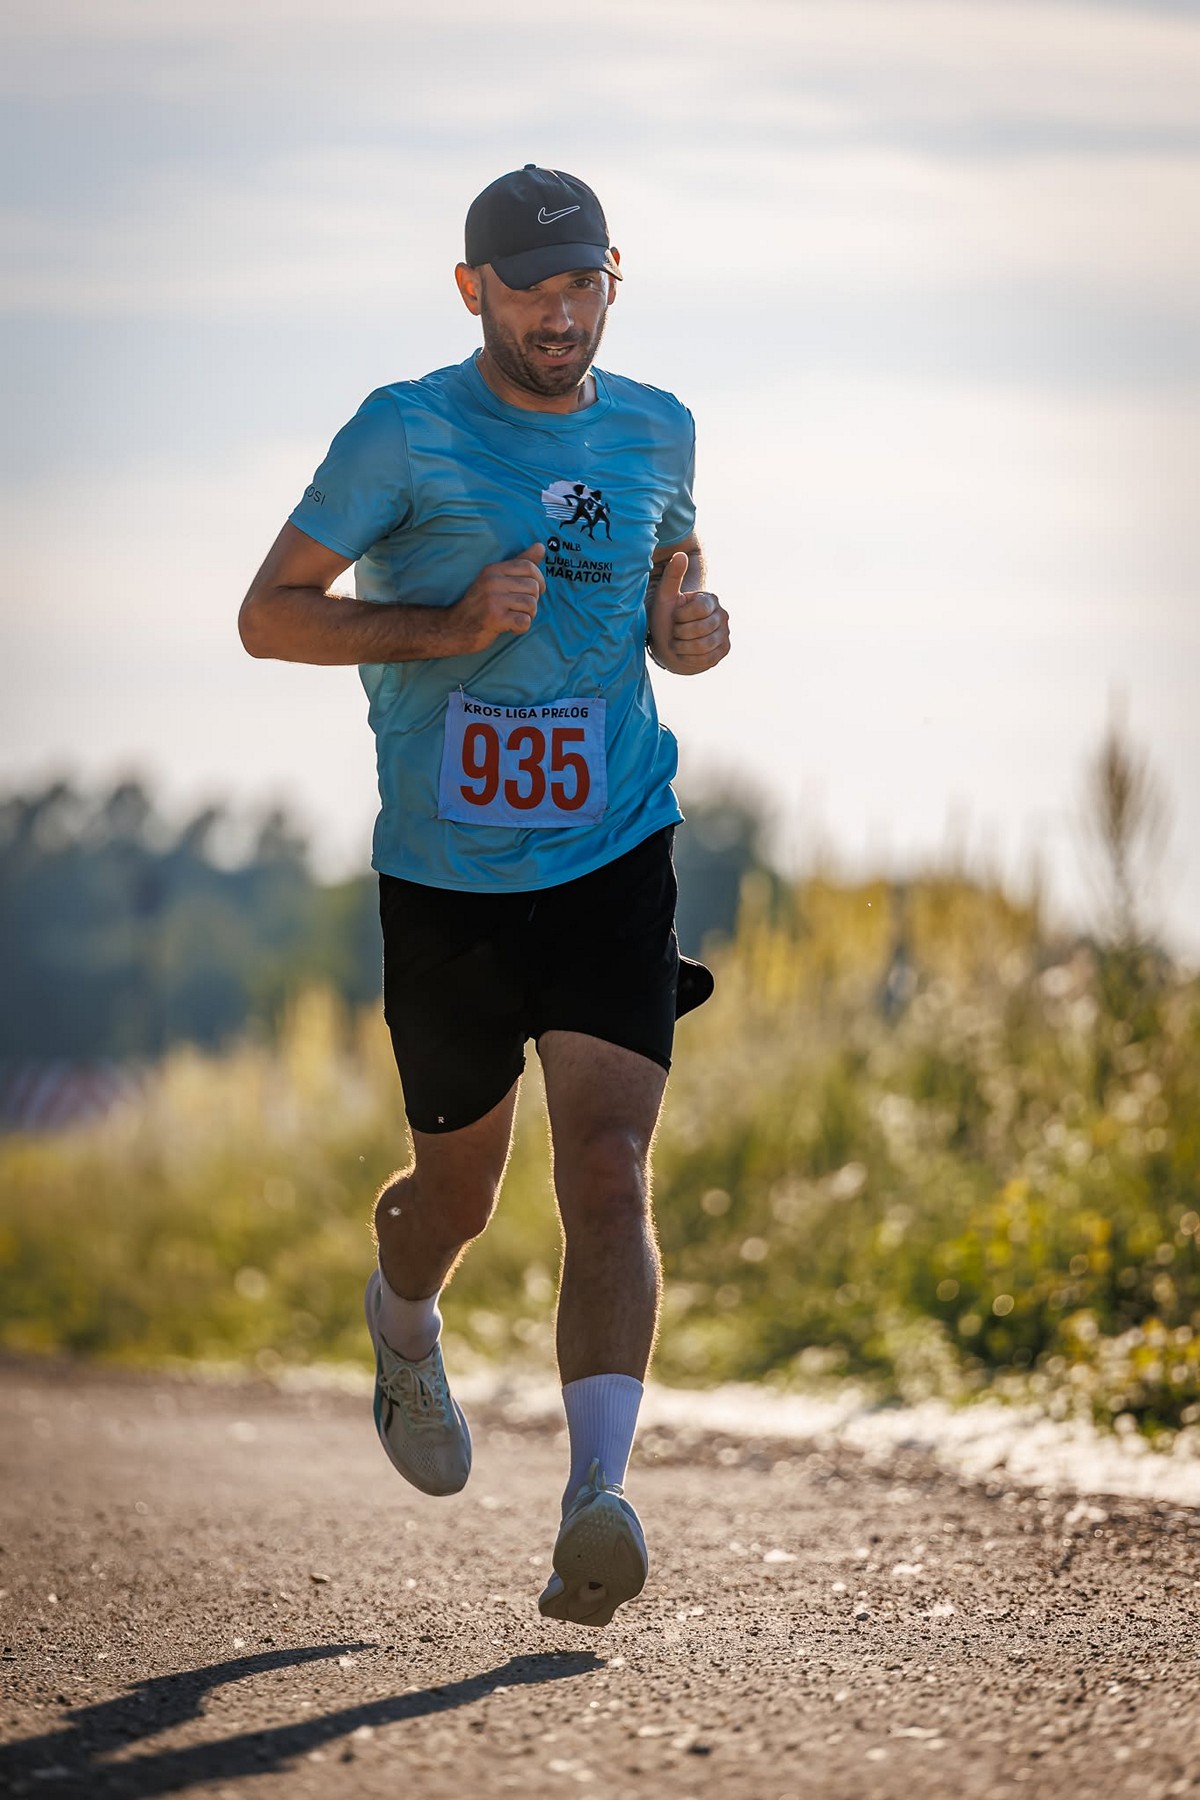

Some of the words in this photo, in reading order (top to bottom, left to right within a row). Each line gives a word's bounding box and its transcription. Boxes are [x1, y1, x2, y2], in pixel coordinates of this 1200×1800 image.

[562, 541, 582, 551] NLB
[545, 556, 612, 571] LJUBLJANSKI
[546, 566, 612, 583] MARATON
[464, 703, 501, 717] KROS
[506, 708, 537, 718] LIGA
[542, 707, 589, 718] PRELOG
[460, 722, 590, 811] 935
